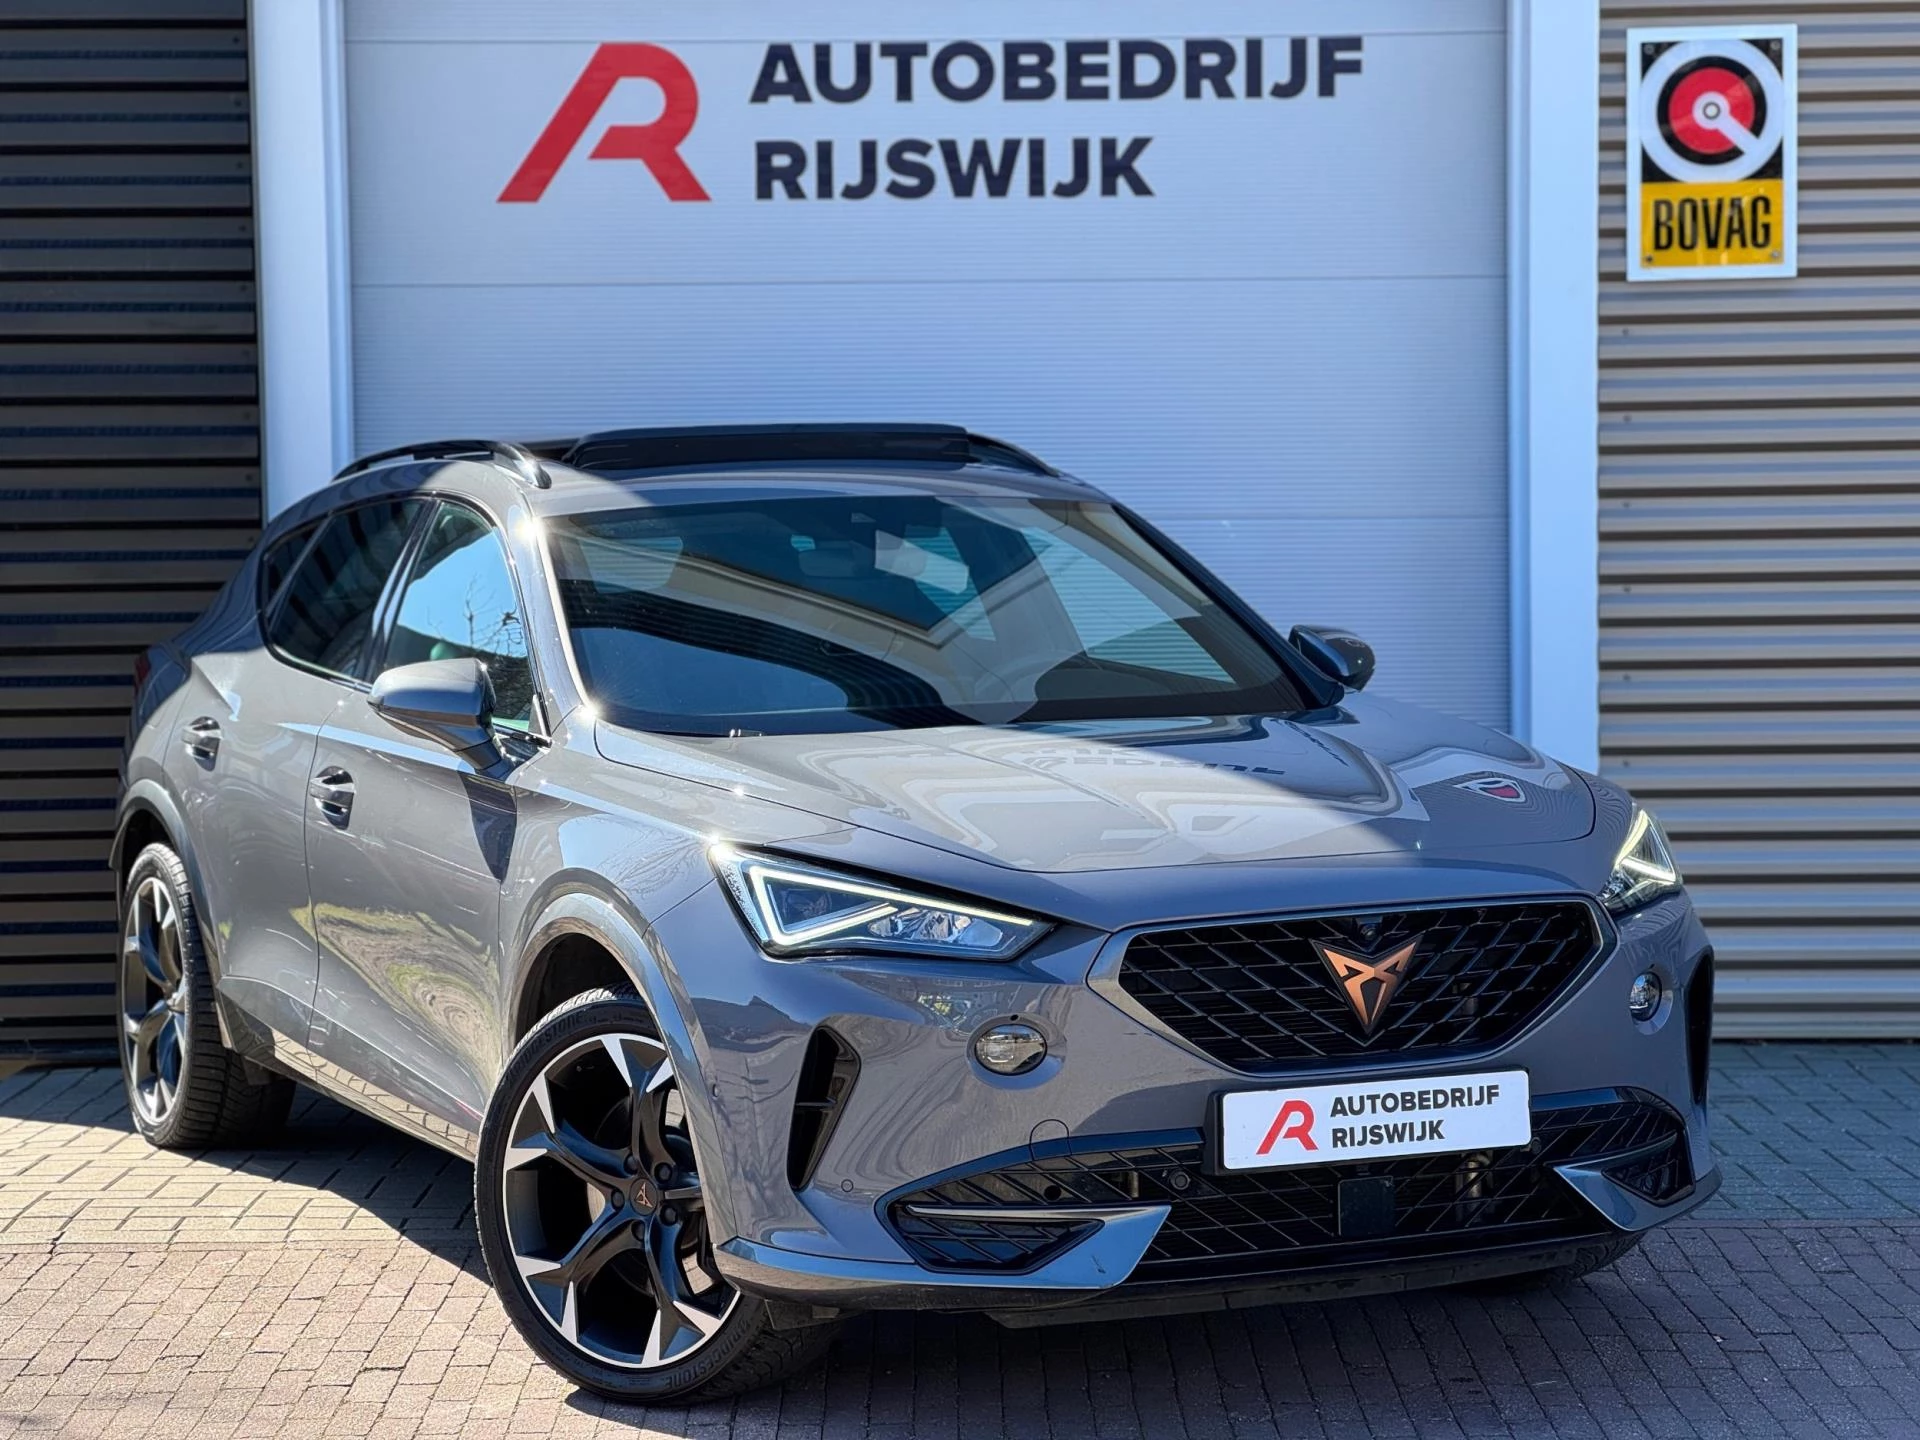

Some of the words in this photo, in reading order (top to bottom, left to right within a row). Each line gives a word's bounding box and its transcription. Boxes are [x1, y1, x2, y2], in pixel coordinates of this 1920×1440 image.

[749, 36, 1364, 104] AUTOBEDRIJF
[755, 137, 1154, 200] RIJSWIJK
[1653, 196, 1771, 251] BOVAG
[1330, 1084, 1500, 1118] AUTOBEDRIJF
[1331, 1119, 1445, 1149] RIJSWIJK
